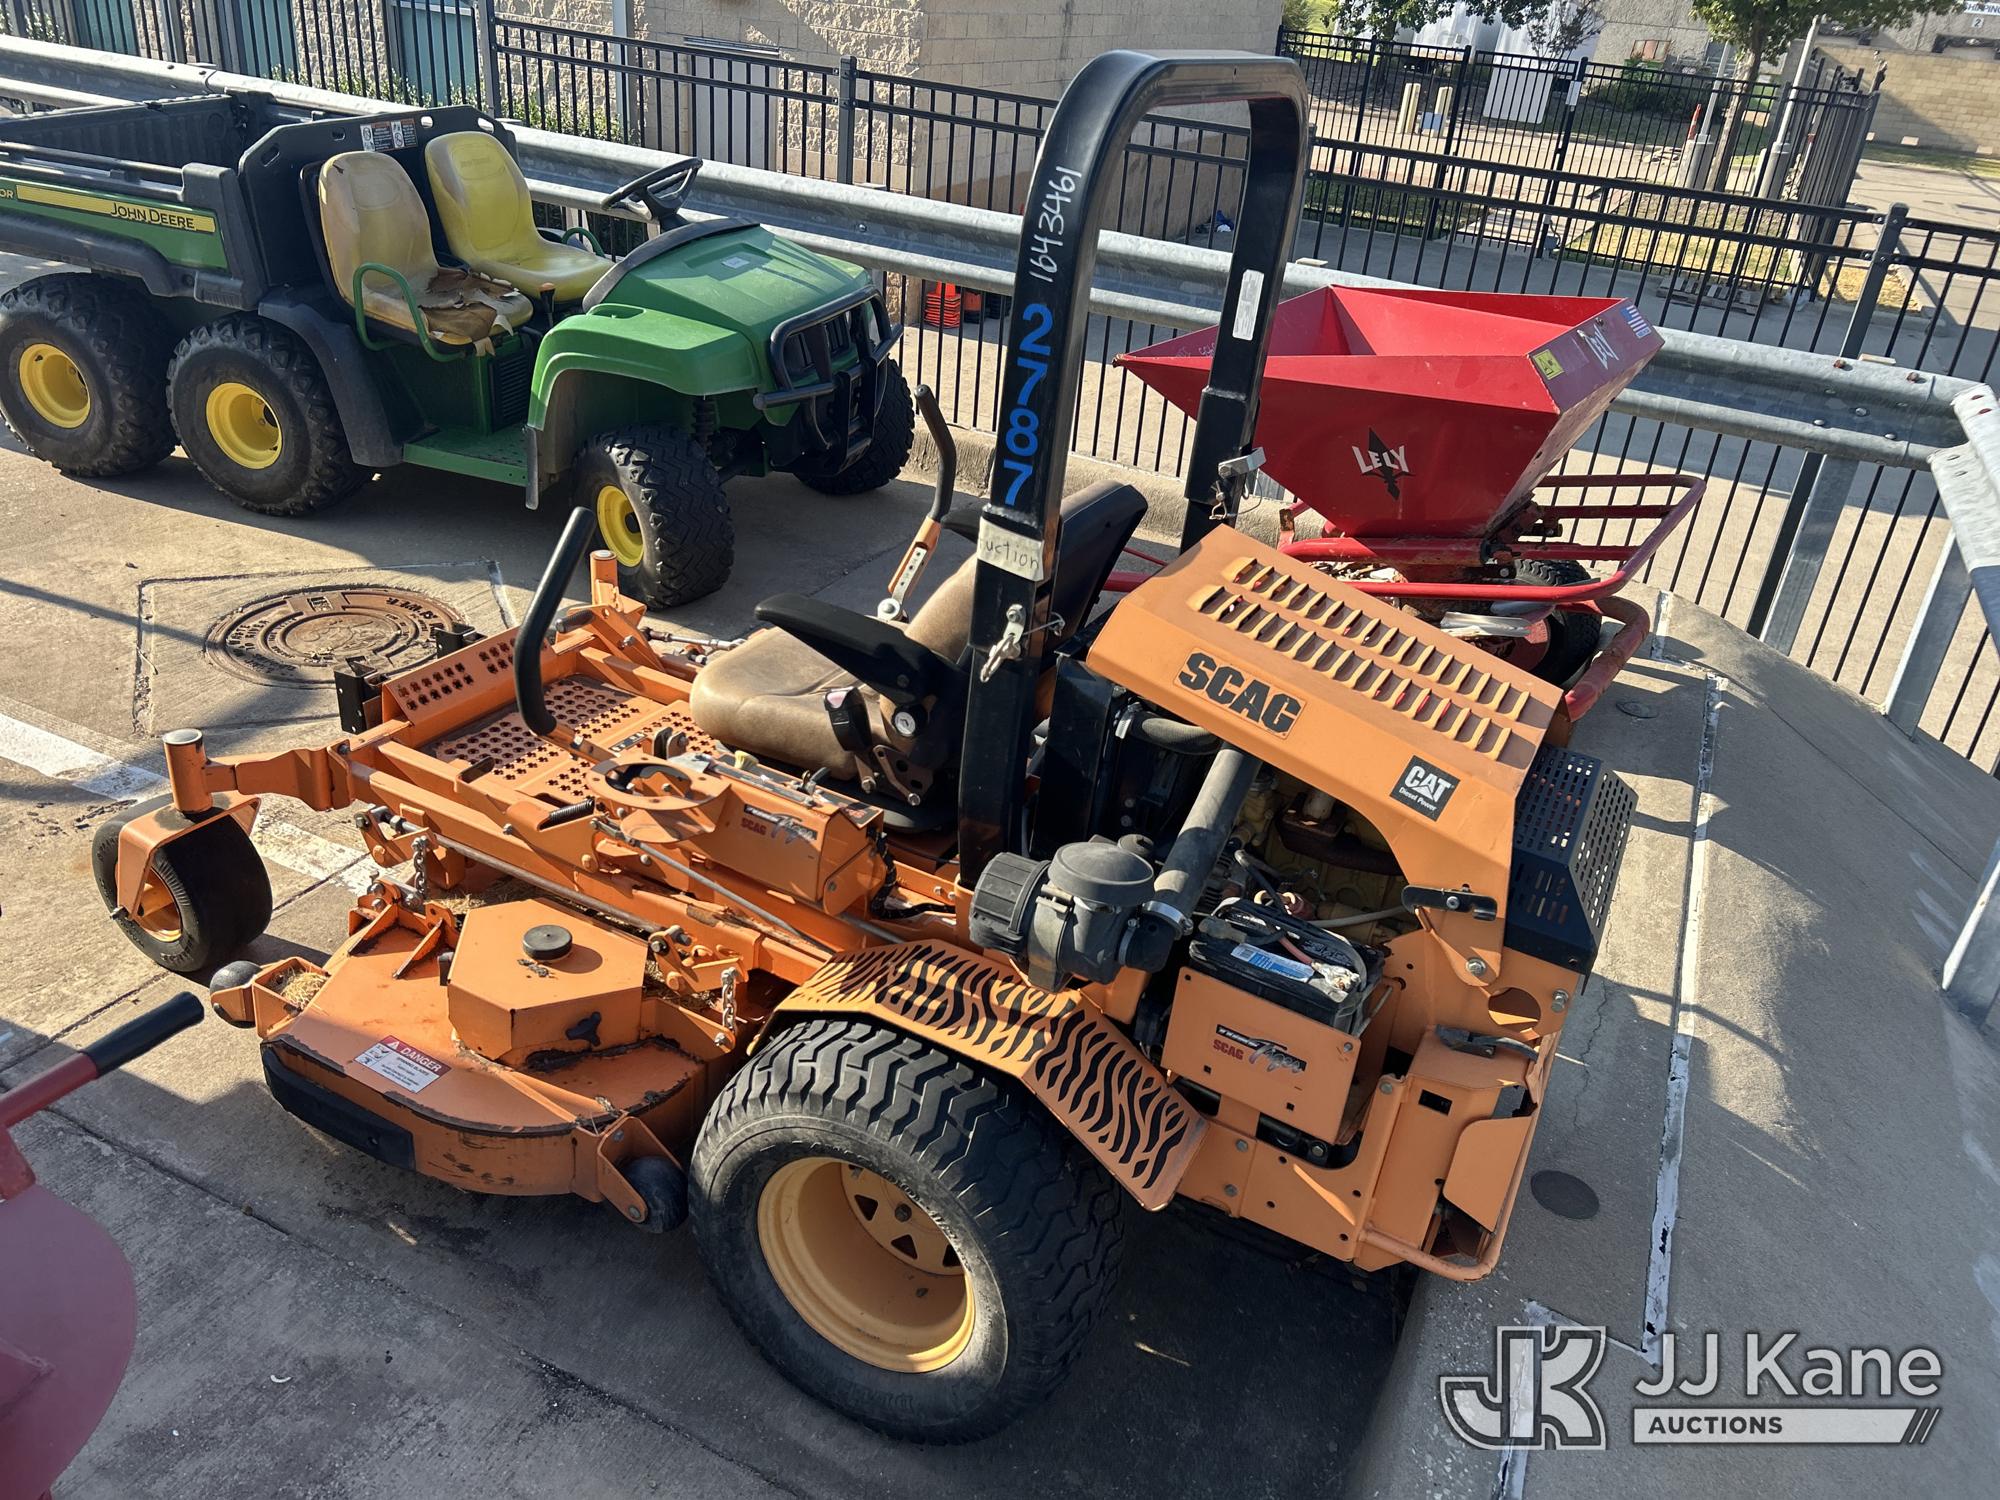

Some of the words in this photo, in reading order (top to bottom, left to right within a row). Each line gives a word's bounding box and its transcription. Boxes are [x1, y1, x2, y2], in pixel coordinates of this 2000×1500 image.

[111, 203, 146, 222] JOHN
[150, 208, 194, 229] DEERE
[1029, 166, 1082, 282] 1643461
[1003, 303, 1053, 506] 2787
[1351, 445, 1409, 473] LELY
[980, 541, 1040, 569] uction
[1178, 652, 1302, 733] SCAG
[1404, 765, 1452, 802] CAT
[1399, 786, 1418, 801] Diesel
[1417, 797, 1437, 811] Power
[400, 1047, 442, 1073] DANGER
[1213, 1038, 1245, 1061] SCAG
